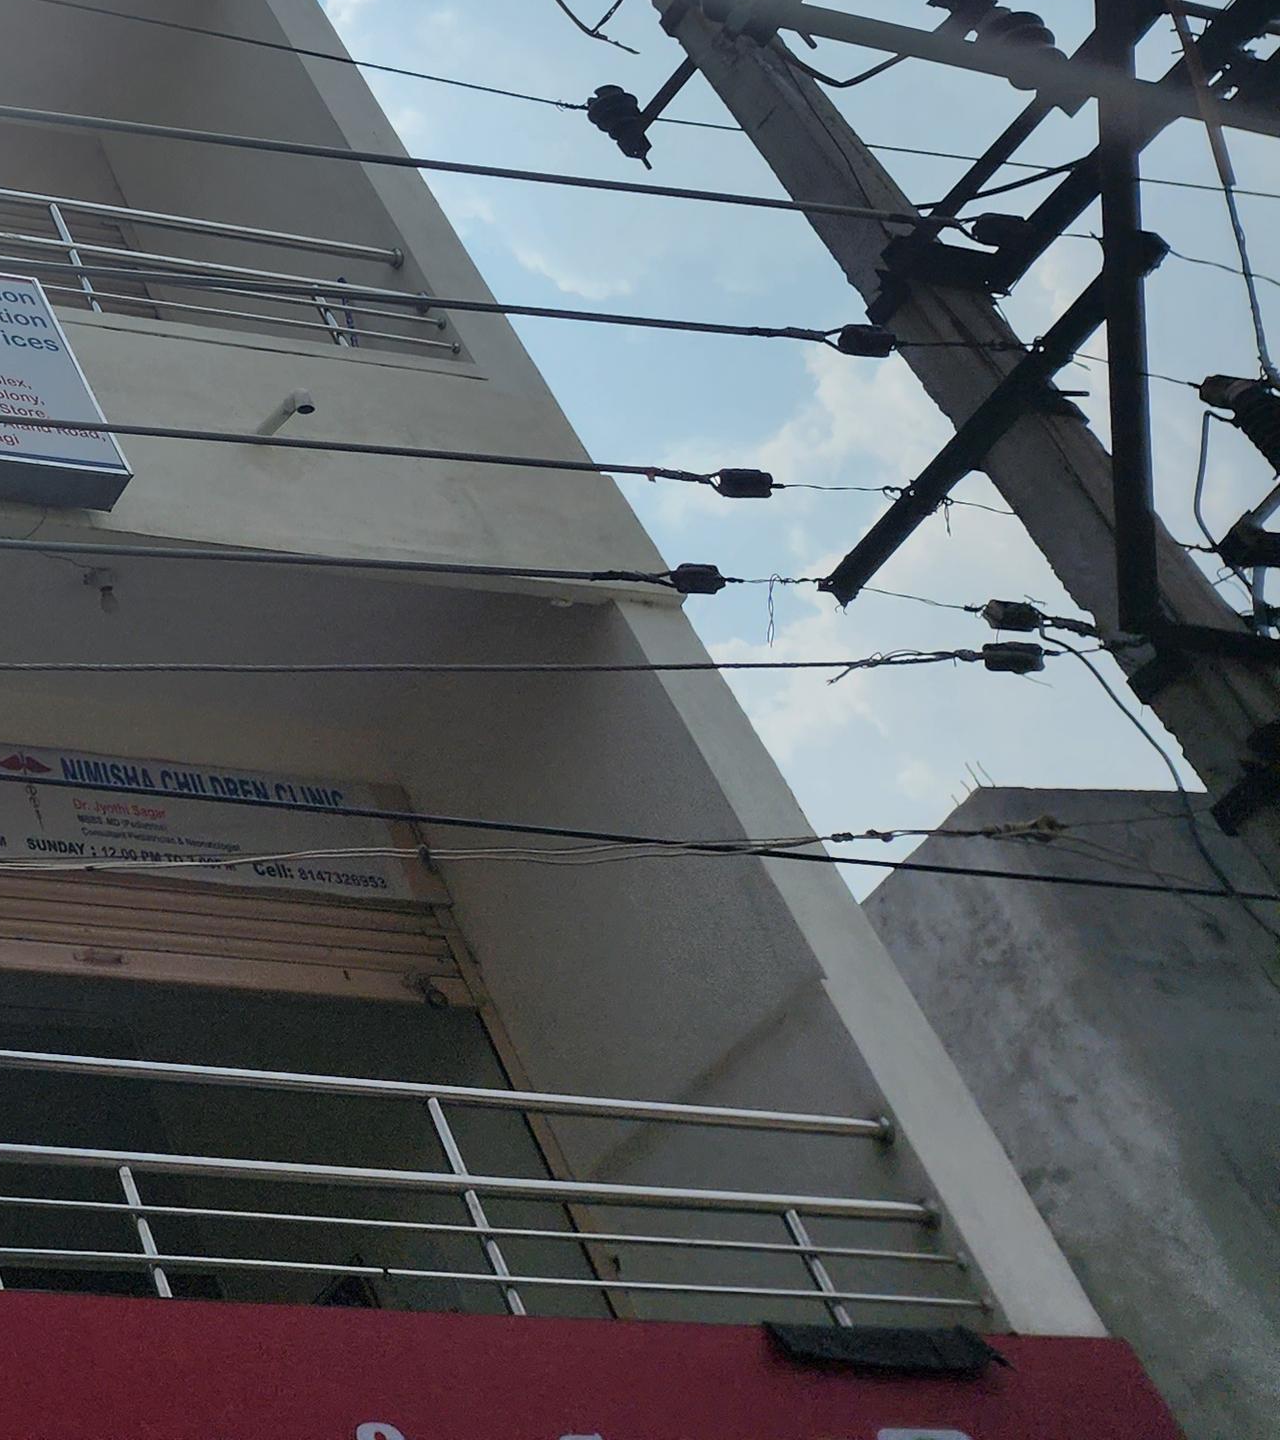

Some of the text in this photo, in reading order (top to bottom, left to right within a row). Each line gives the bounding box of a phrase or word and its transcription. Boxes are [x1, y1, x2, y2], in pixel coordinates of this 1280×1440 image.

[60, 757, 154, 792] NIMISHA
[26, 837, 85, 856] SUNDAY
[253, 862, 295, 880] Cell:
